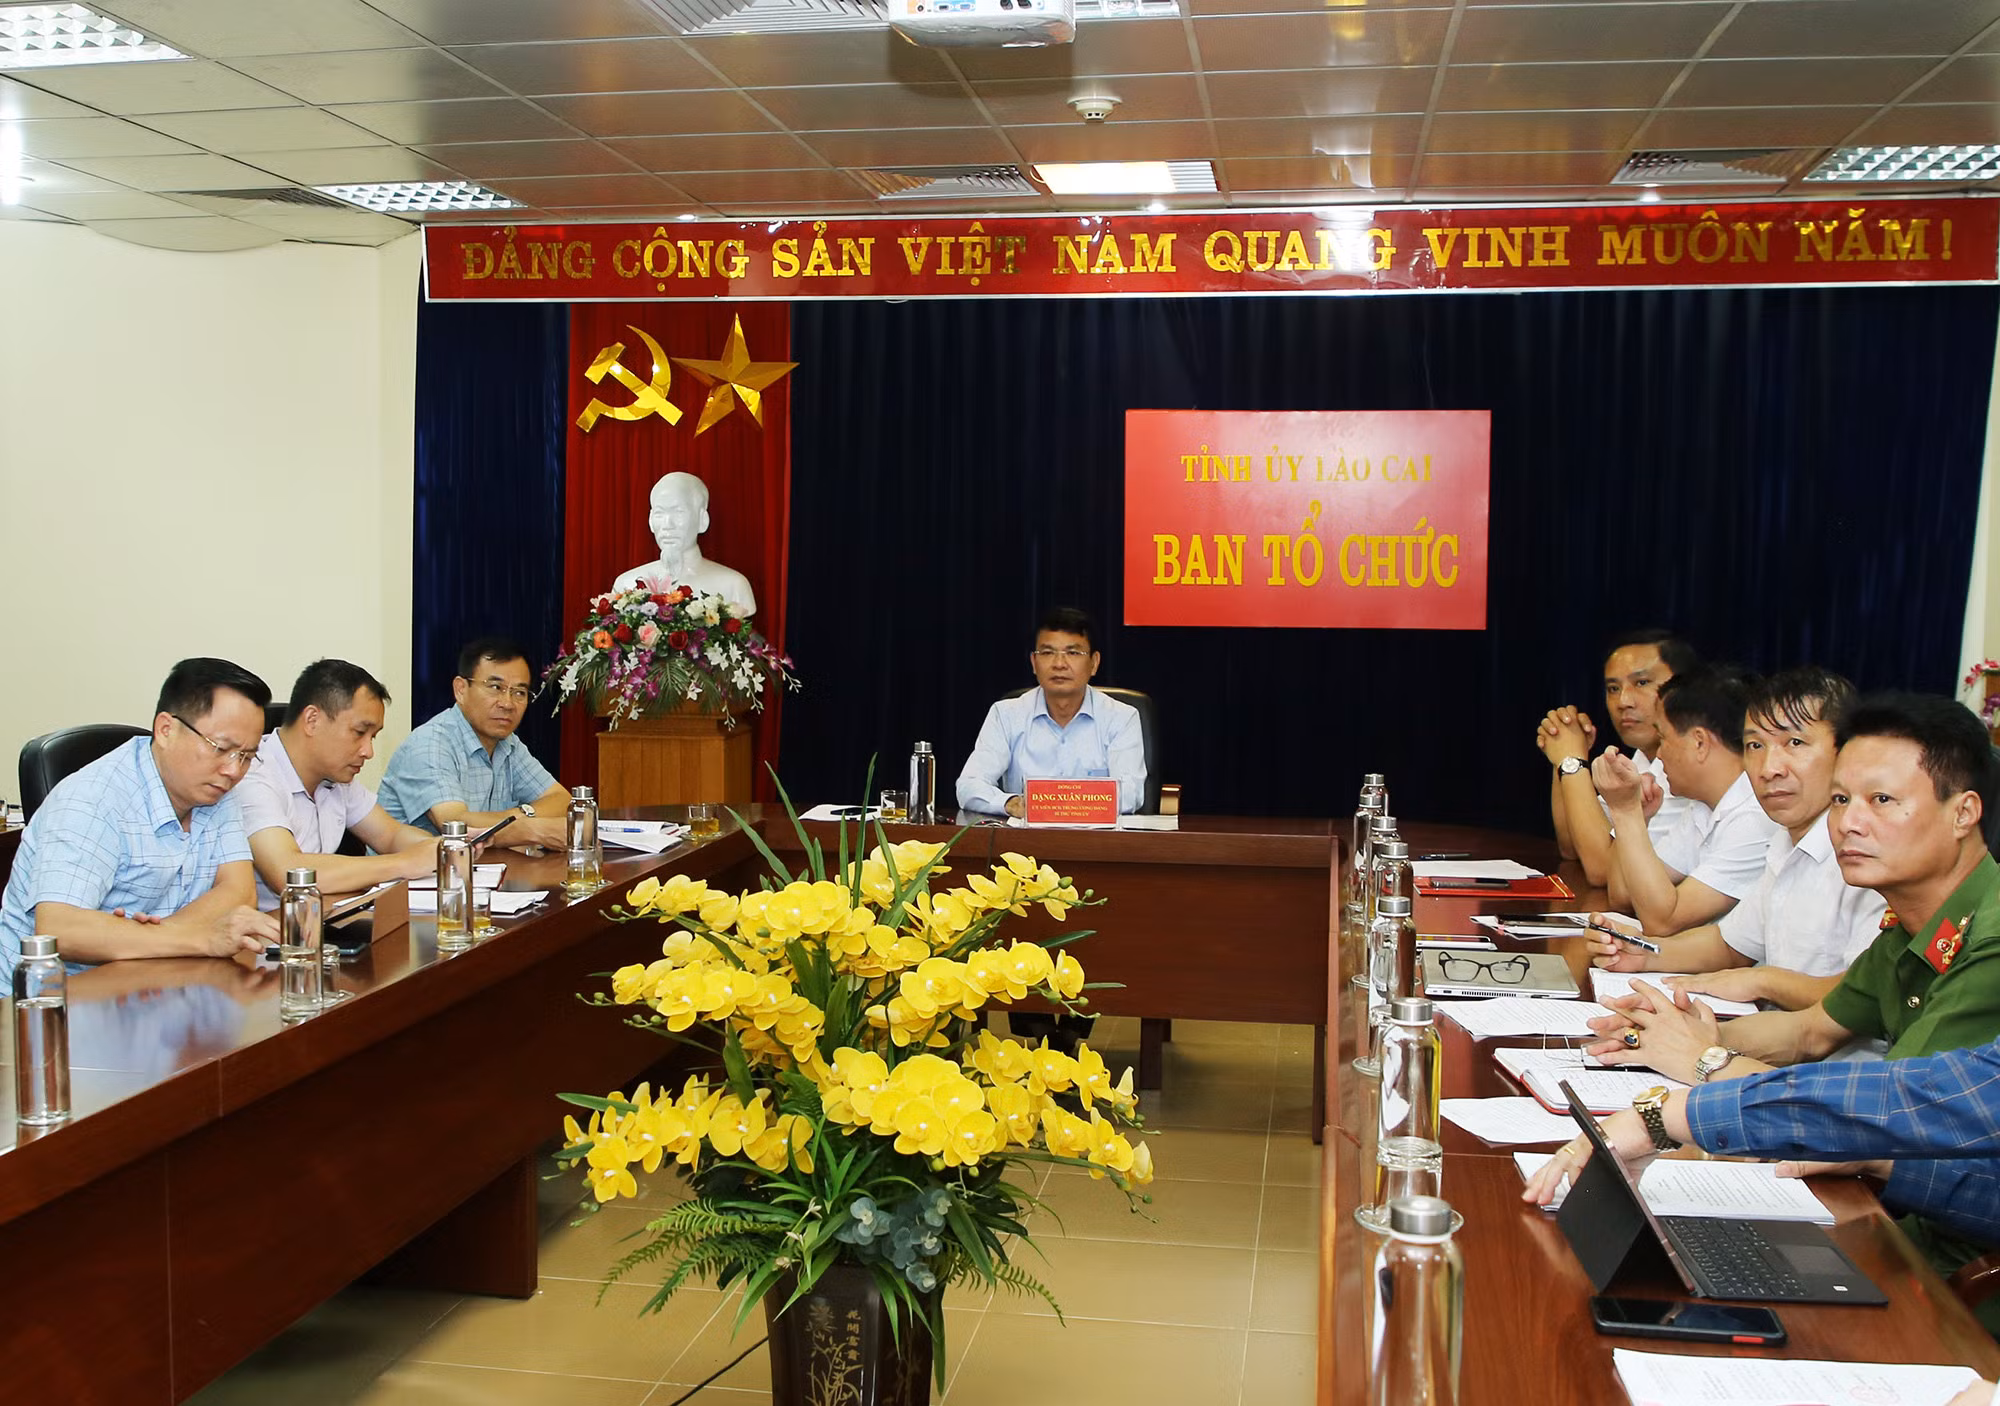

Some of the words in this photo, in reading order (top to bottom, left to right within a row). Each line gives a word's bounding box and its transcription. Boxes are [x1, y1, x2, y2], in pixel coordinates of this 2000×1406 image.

[462, 225, 596, 280] ĐẢNG
[612, 226, 751, 292] CỘNG
[771, 220, 876, 279] SẢN
[897, 221, 1027, 287] VIỆT
[1052, 232, 1178, 275] NAM
[1203, 227, 1397, 273] QUANG
[1422, 226, 1570, 269] VINH
[1596, 208, 1774, 267] MUÔN
[1180, 444, 1251, 483] TỈNH
[1265, 444, 1304, 482] ỦY
[1315, 448, 1371, 482] LÀO
[1381, 454, 1433, 482] CAI
[1153, 534, 1247, 585] BAN
[1263, 500, 1325, 587] TỔ
[1338, 516, 1459, 588] CHỨC
[1057, 792, 1081, 801] XUÂN
[1082, 794, 1113, 802] PHONG
